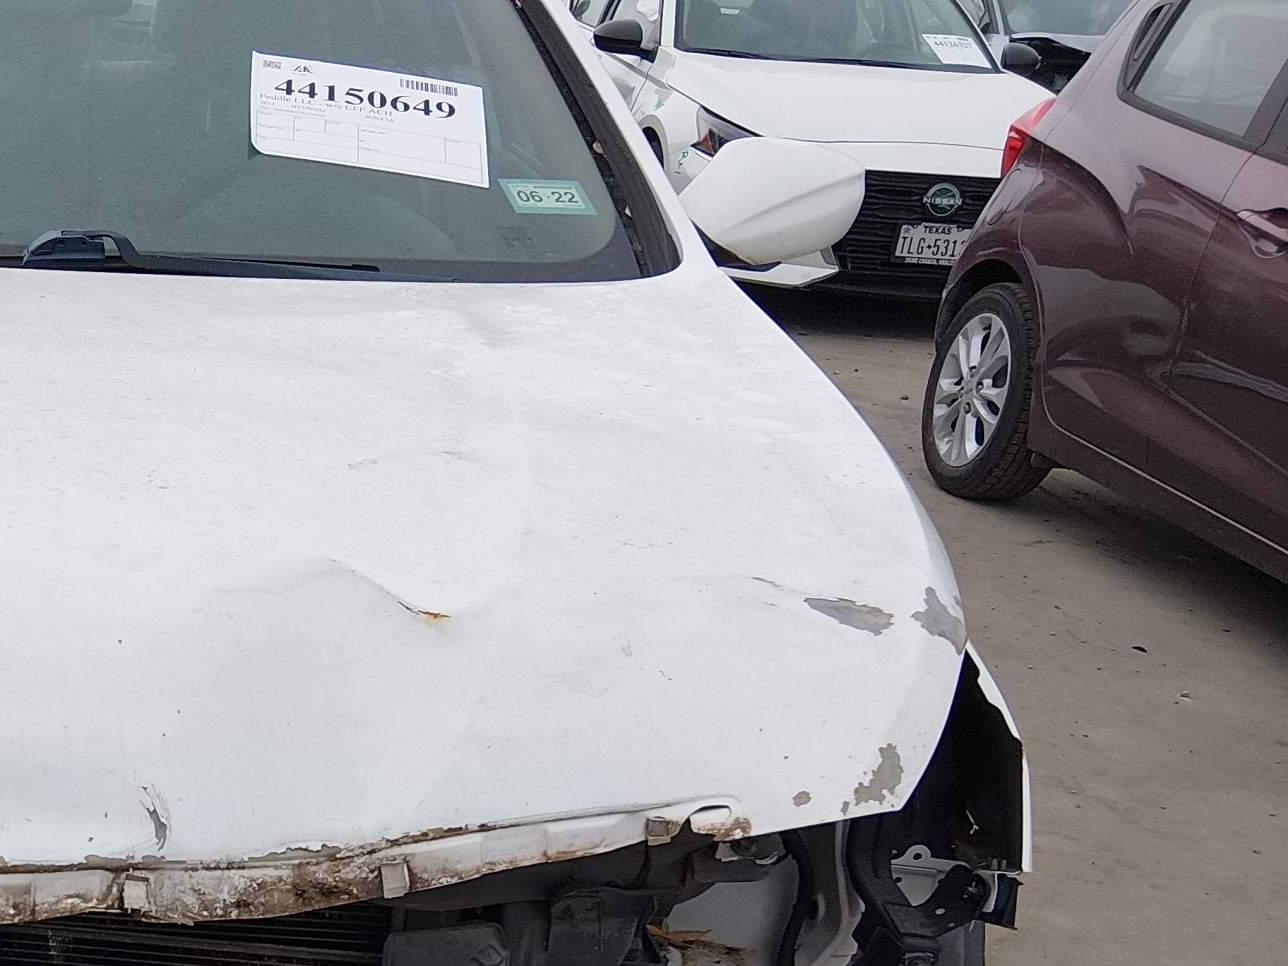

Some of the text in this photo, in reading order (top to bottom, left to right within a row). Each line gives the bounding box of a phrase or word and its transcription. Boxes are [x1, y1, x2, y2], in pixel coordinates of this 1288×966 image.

[274, 79, 457, 119] 44150649
[923, 196, 963, 206] NISSAN
[923, 225, 952, 235] TEXAS
